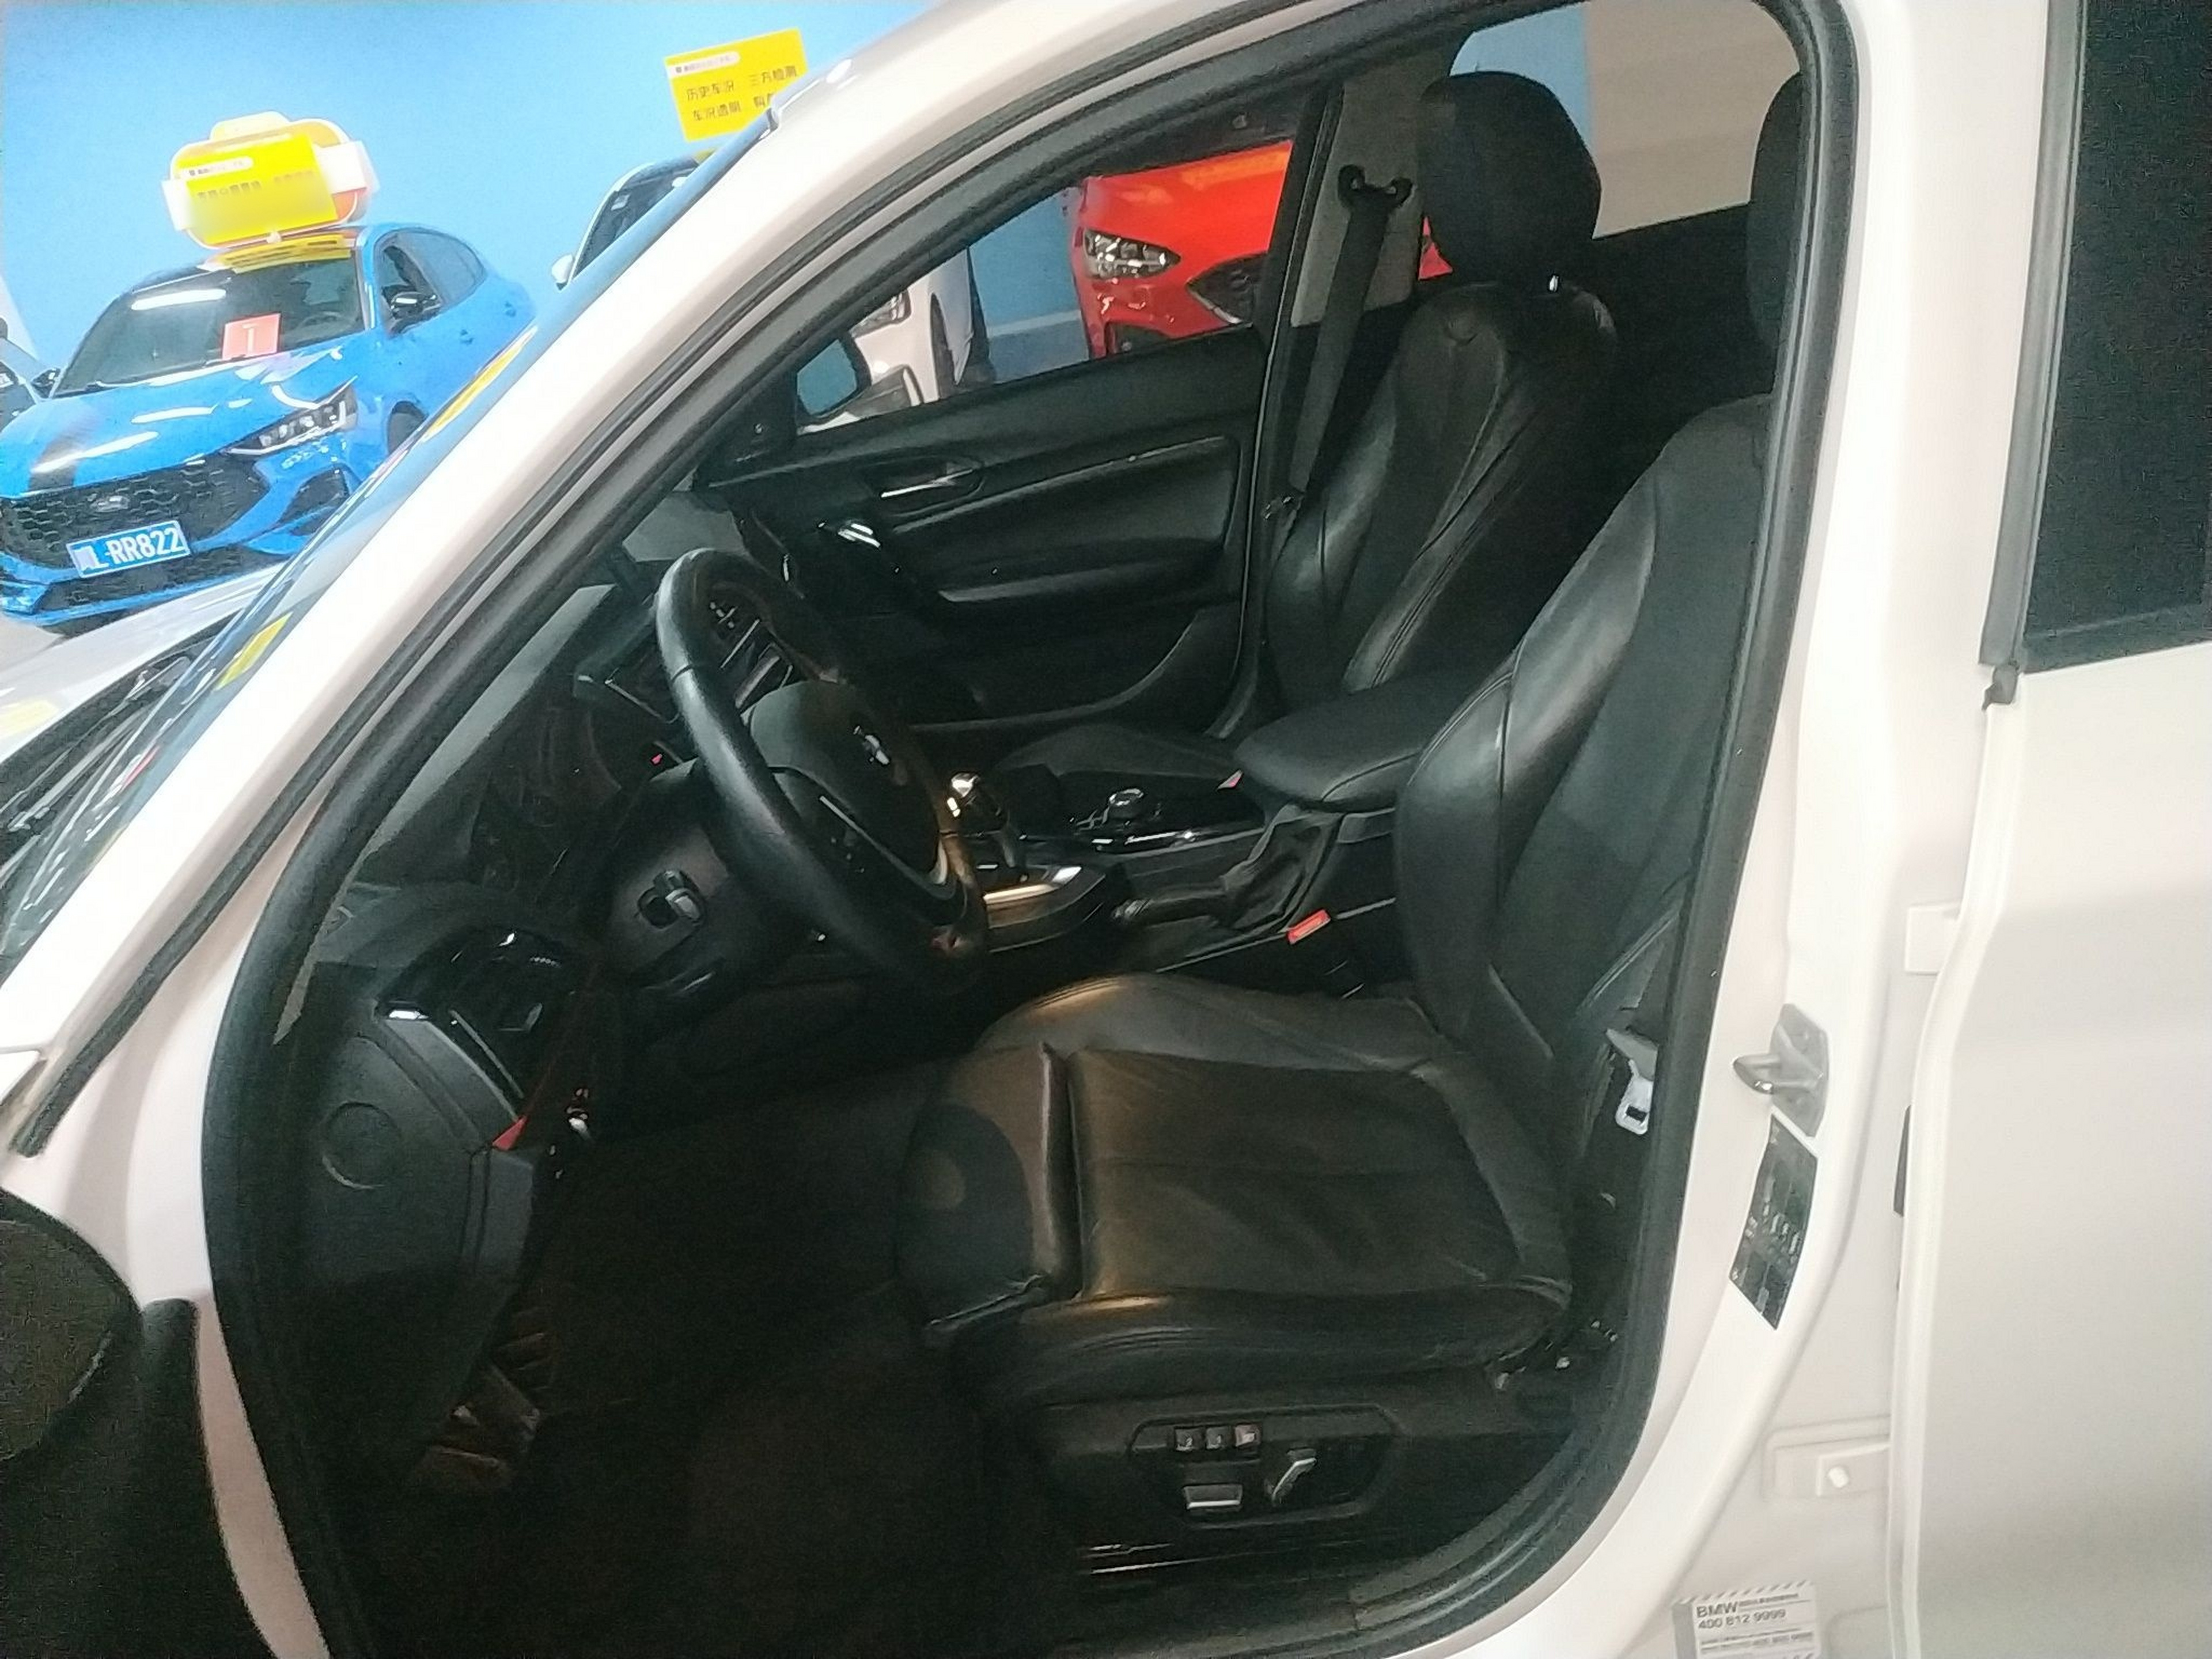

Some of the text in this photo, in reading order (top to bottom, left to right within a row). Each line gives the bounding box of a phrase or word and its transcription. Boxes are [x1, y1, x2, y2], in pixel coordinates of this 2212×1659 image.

[686, 66, 797, 101] 历史车况 三方检测
[693, 100, 741, 121] 车况透明
[1696, 1601, 1738, 1619] BMW
[1698, 1609, 1786, 1629] 400 812 9999
